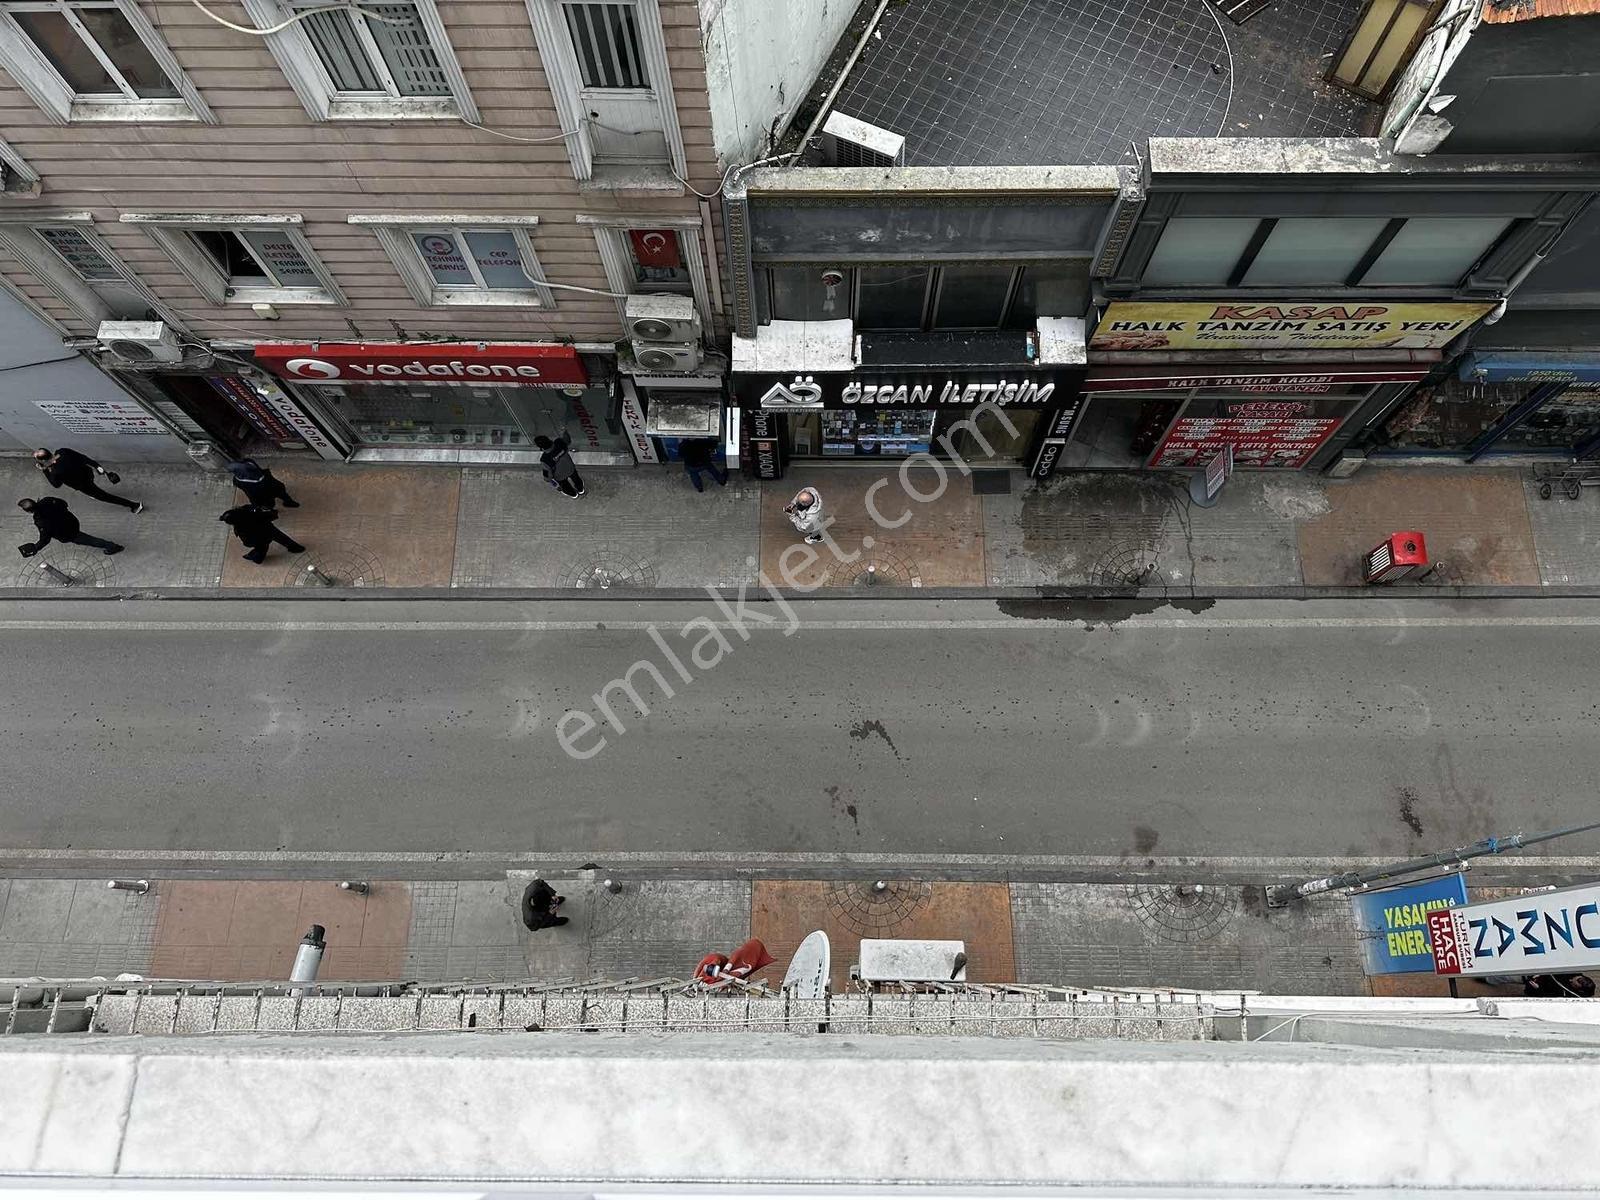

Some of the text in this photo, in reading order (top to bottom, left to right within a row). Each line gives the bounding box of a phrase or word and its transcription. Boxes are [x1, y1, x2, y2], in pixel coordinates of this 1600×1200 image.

[489, 250, 509, 258] CEP
[1210, 305, 1389, 321] KASAP
[1110, 319, 1465, 334] HALK TANZİM SATIŞ YERİ
[349, 361, 540, 378] vodafone
[842, 379, 1056, 406] ÖZCAN İLETİŞİM
[1167, 378, 1209, 388] HALK
[274, 396, 328, 449] vodafone
[754, 408, 770, 437] Phone
[1197, 441, 1236, 449] TANZM
[1239, 441, 1267, 450] SATIŞ
[1270, 441, 1317, 449] NOKTASI
[1038, 446, 1058, 476] oppo
[1430, 916, 1447, 970] UMRE
[1439, 916, 1458, 967] HAC
